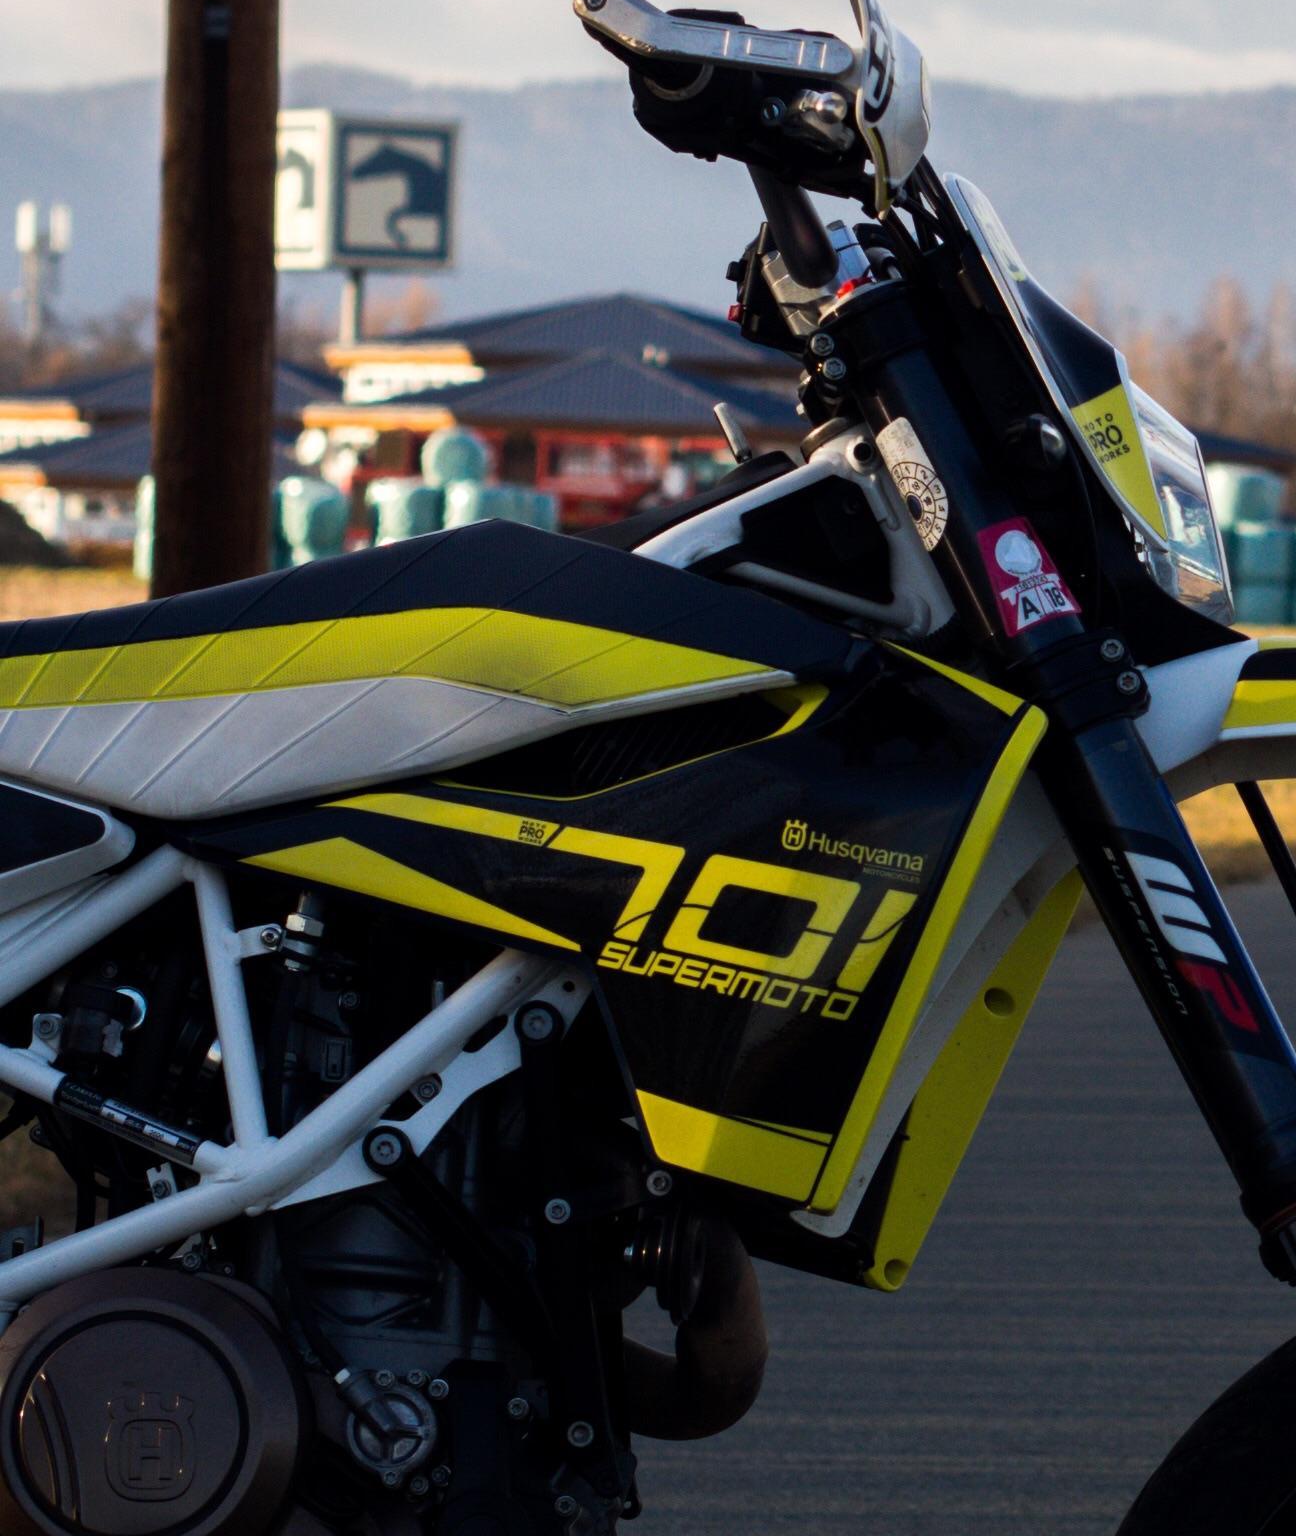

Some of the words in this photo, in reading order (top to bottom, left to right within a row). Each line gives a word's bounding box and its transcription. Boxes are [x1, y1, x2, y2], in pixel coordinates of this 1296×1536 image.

[1021, 596, 1041, 620] A
[1045, 587, 1067, 608] 18
[519, 825, 545, 839] PRO
[808, 830, 924, 873] Husqvarna
[548, 826, 918, 993] 701
[597, 940, 860, 1021] SUPERMOTO
